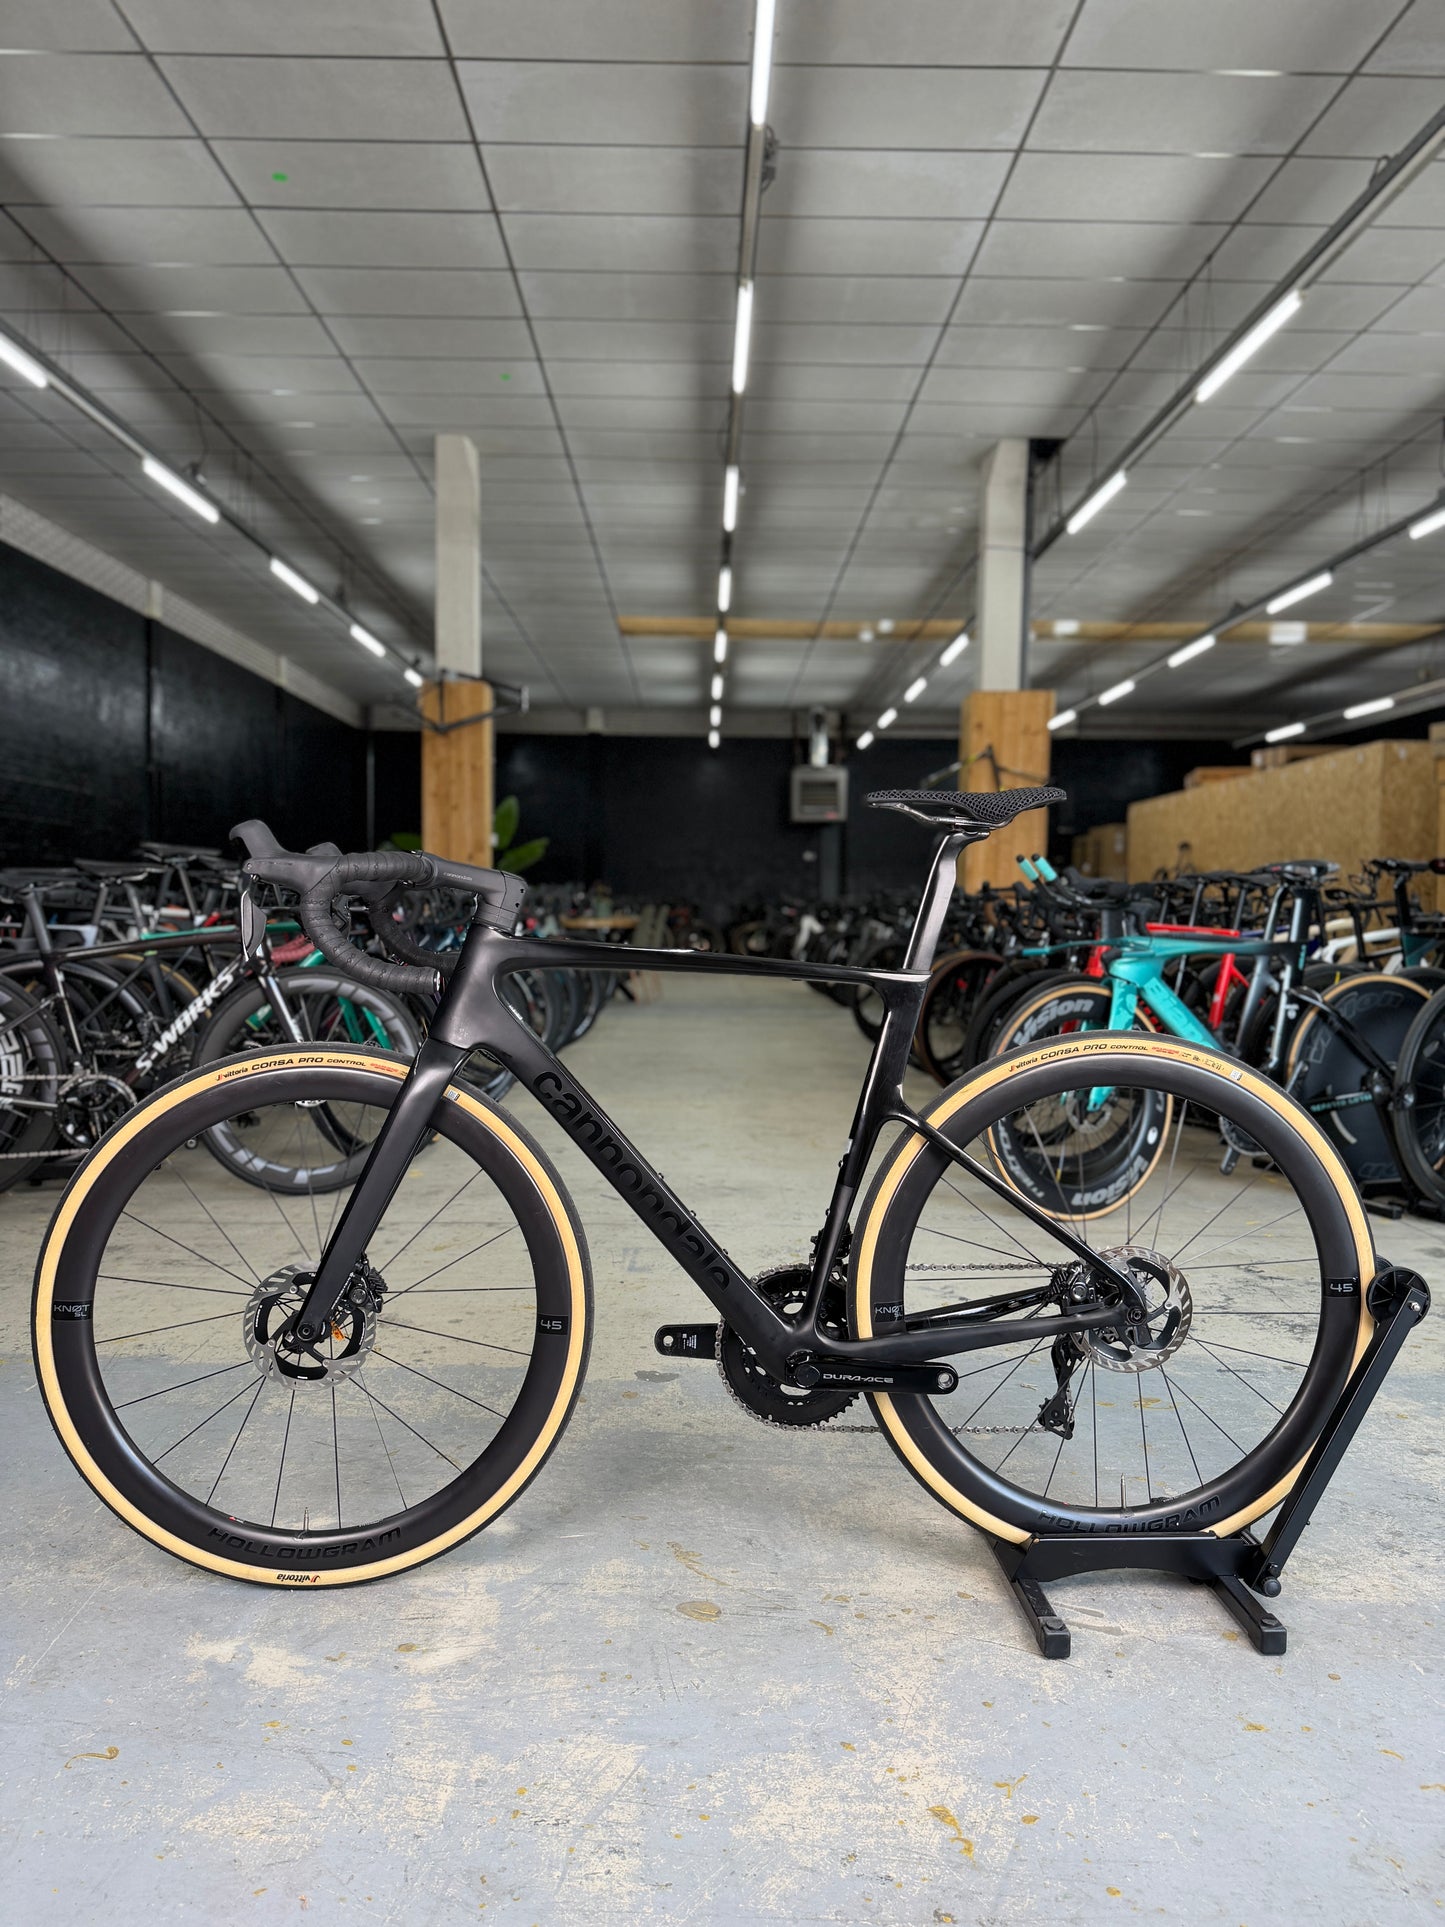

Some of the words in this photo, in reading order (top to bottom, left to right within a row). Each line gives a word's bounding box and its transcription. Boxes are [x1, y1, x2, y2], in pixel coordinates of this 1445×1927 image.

[136, 955, 241, 1077] S-WORKS
[1040, 1047, 1080, 1060] CORSA
[1083, 1043, 1107, 1051] PRO
[251, 1059, 294, 1071] CORSA
[326, 1058, 367, 1067] CONTROL
[533, 1071, 730, 1290] cannondale
[1329, 1283, 1354, 1292] 45
[540, 1319, 562, 1330] 45
[823, 1373, 894, 1384] DURA-ACE
[1038, 1495, 1221, 1533] HOLLOWGRAM
[207, 1526, 401, 1560] HOLLOWGRAM
[276, 1573, 311, 1583] vittoria
